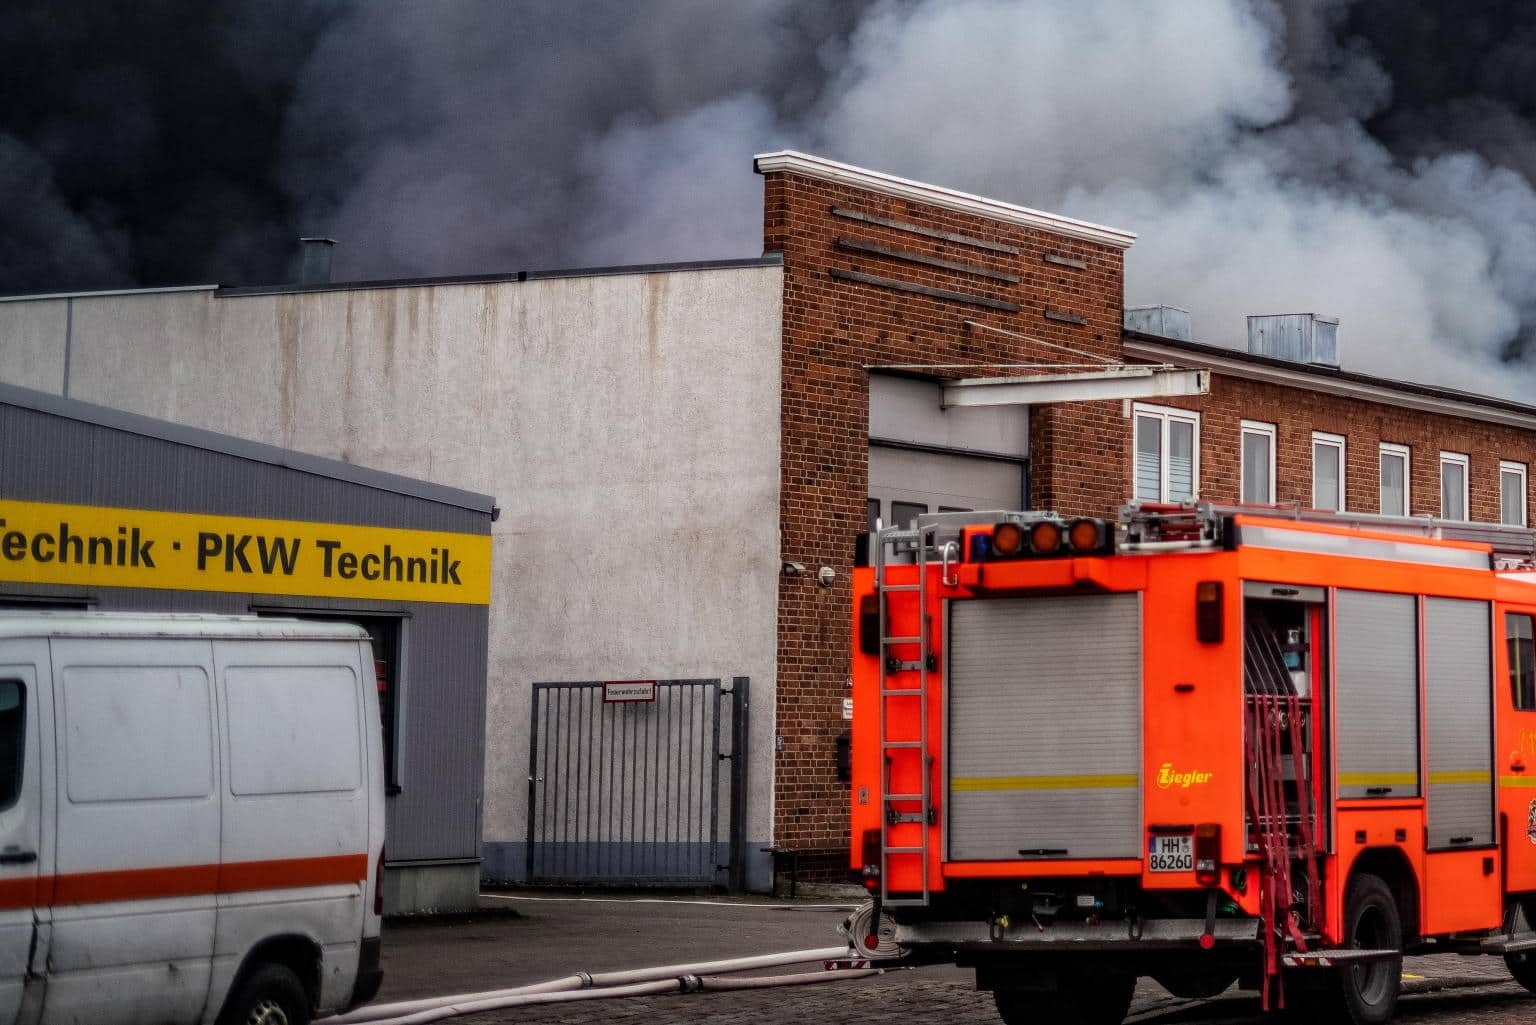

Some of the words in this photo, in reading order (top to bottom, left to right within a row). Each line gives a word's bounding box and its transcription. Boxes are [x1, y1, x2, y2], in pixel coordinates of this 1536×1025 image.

[197, 531, 301, 576] PKW
[316, 539, 463, 586] Technik
[1157, 763, 1213, 789] Ziegler
[1161, 838, 1180, 853] HH
[1150, 855, 1193, 870] 86260
